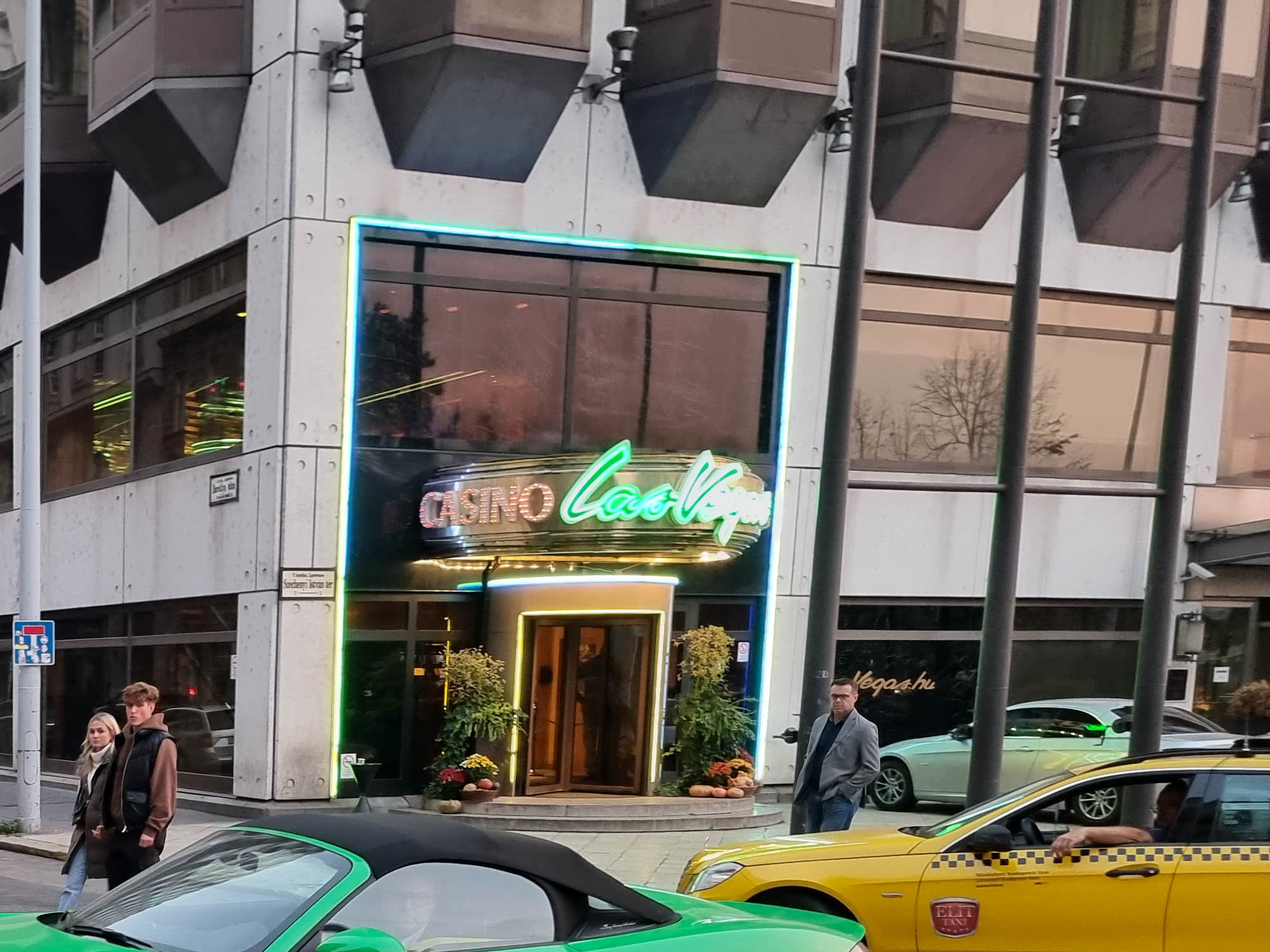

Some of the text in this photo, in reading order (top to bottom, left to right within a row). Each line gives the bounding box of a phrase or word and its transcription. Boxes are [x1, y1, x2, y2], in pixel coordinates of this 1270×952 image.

[419, 438, 772, 547] CASINO Las Vegas
[935, 904, 977, 918] ELIT
[942, 918, 968, 927] TAXI
